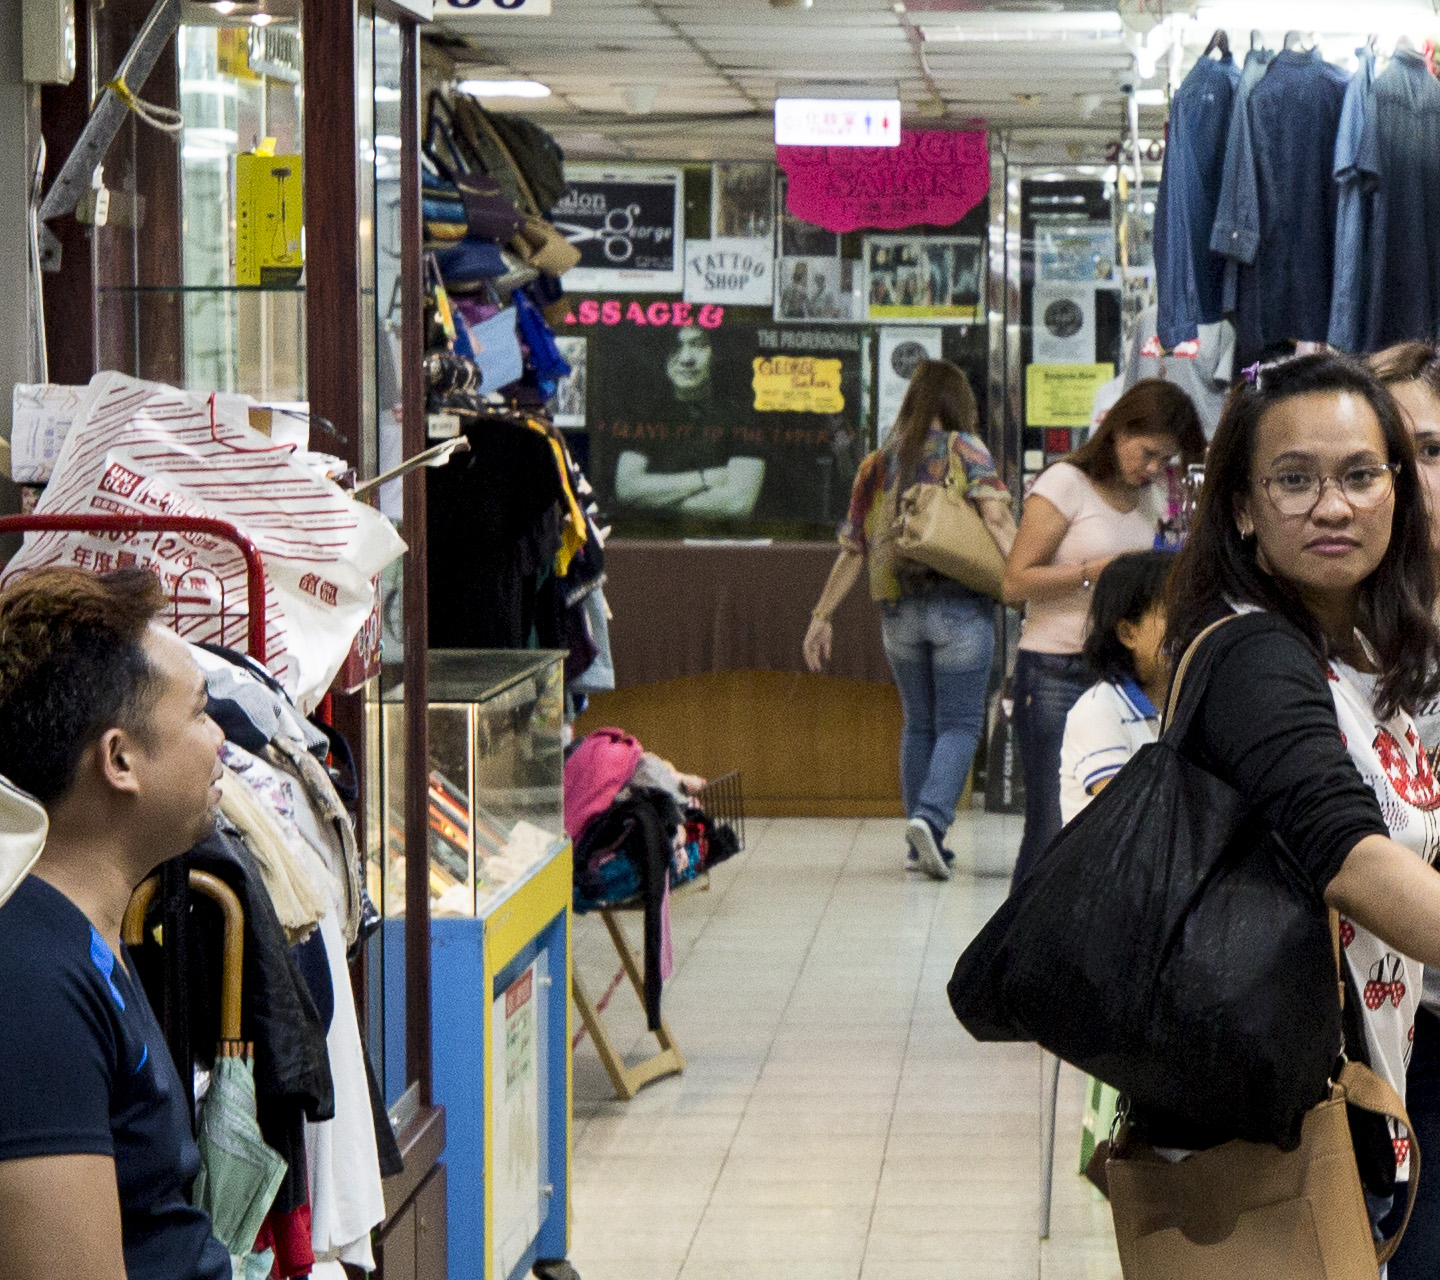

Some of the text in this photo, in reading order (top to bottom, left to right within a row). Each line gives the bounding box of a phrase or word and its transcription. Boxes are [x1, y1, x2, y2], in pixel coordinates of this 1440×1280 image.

[689, 252, 765, 278] TATTOO
[704, 274, 751, 291] SHOP
[564, 299, 693, 327] SSAGE
[110, 463, 139, 484] UNI
